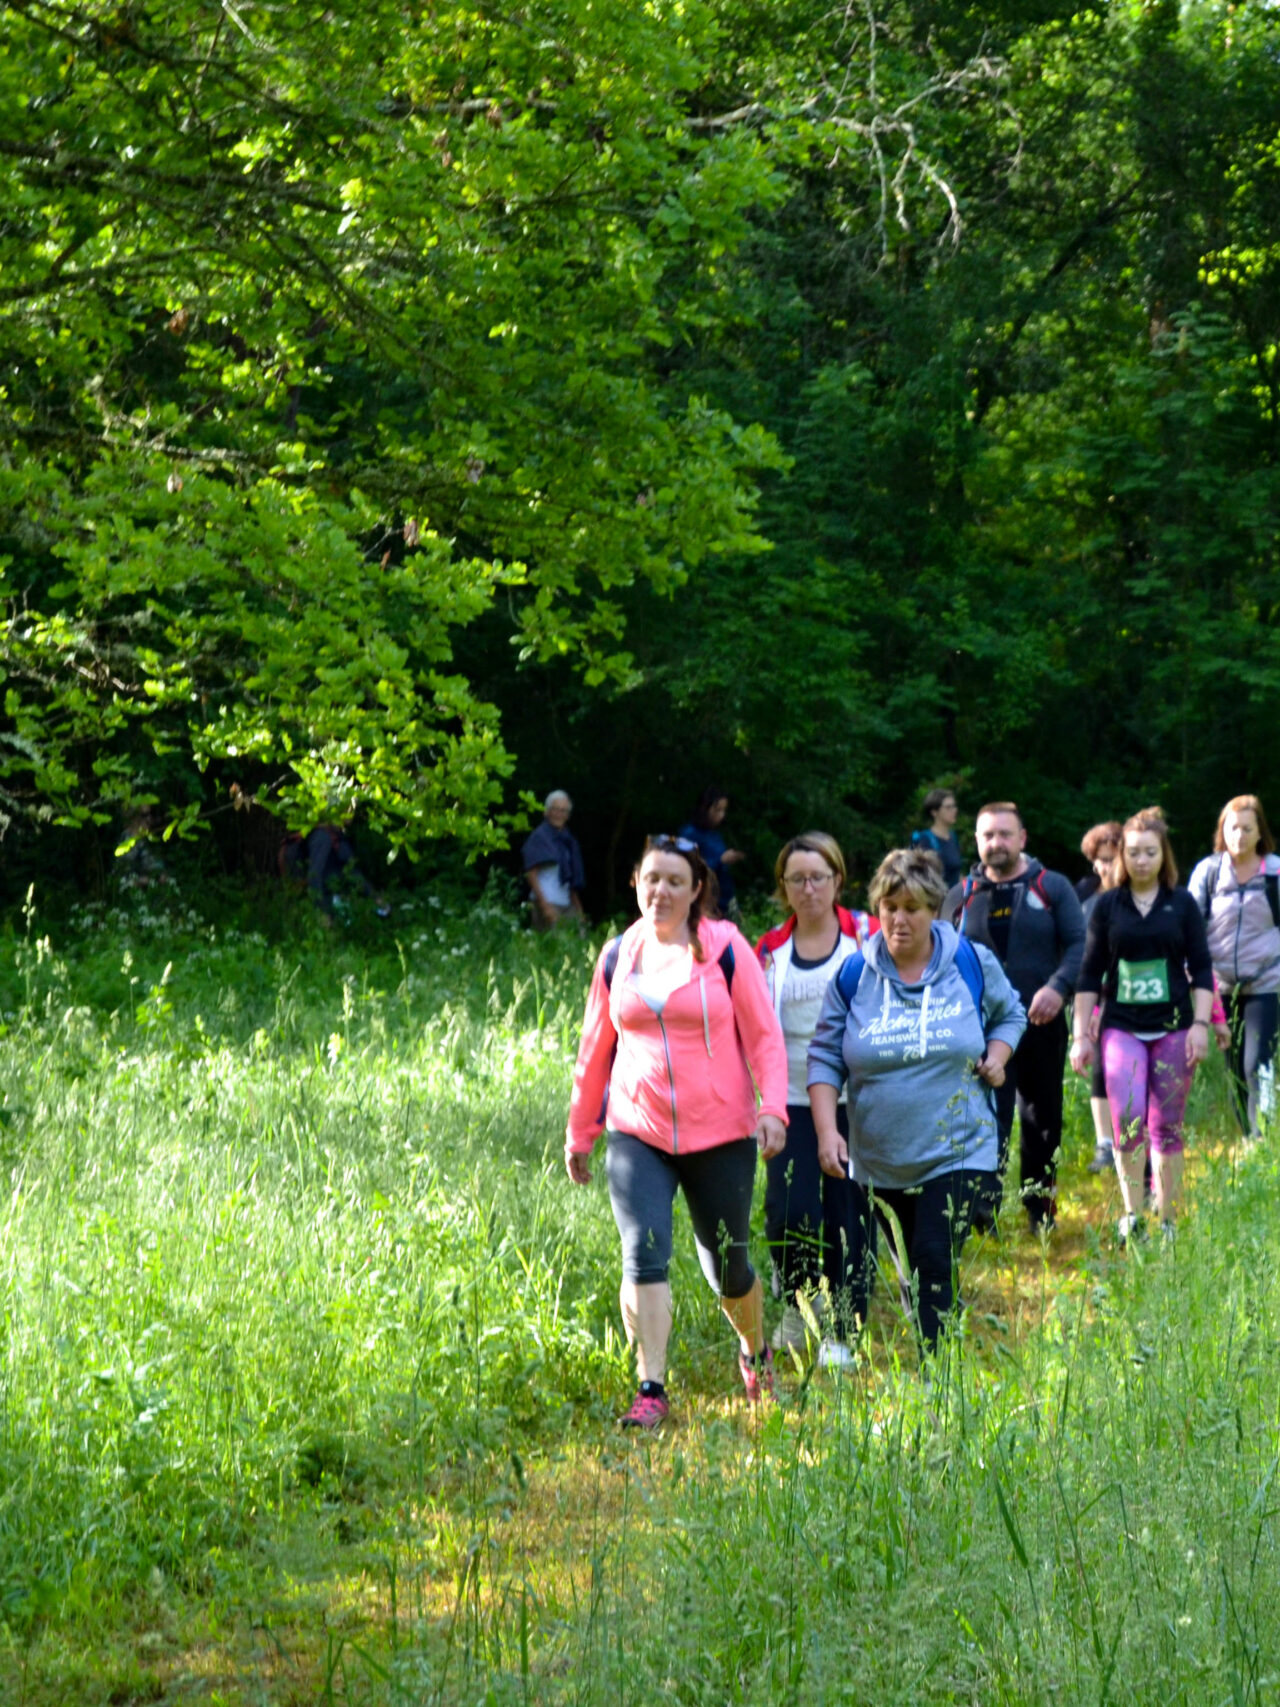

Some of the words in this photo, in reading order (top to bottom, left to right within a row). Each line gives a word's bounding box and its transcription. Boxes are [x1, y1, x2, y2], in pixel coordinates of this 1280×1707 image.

[1122, 979, 1164, 1000] 723
[870, 1031, 934, 1046] JEANSWER
[936, 1028, 955, 1039] CO.
